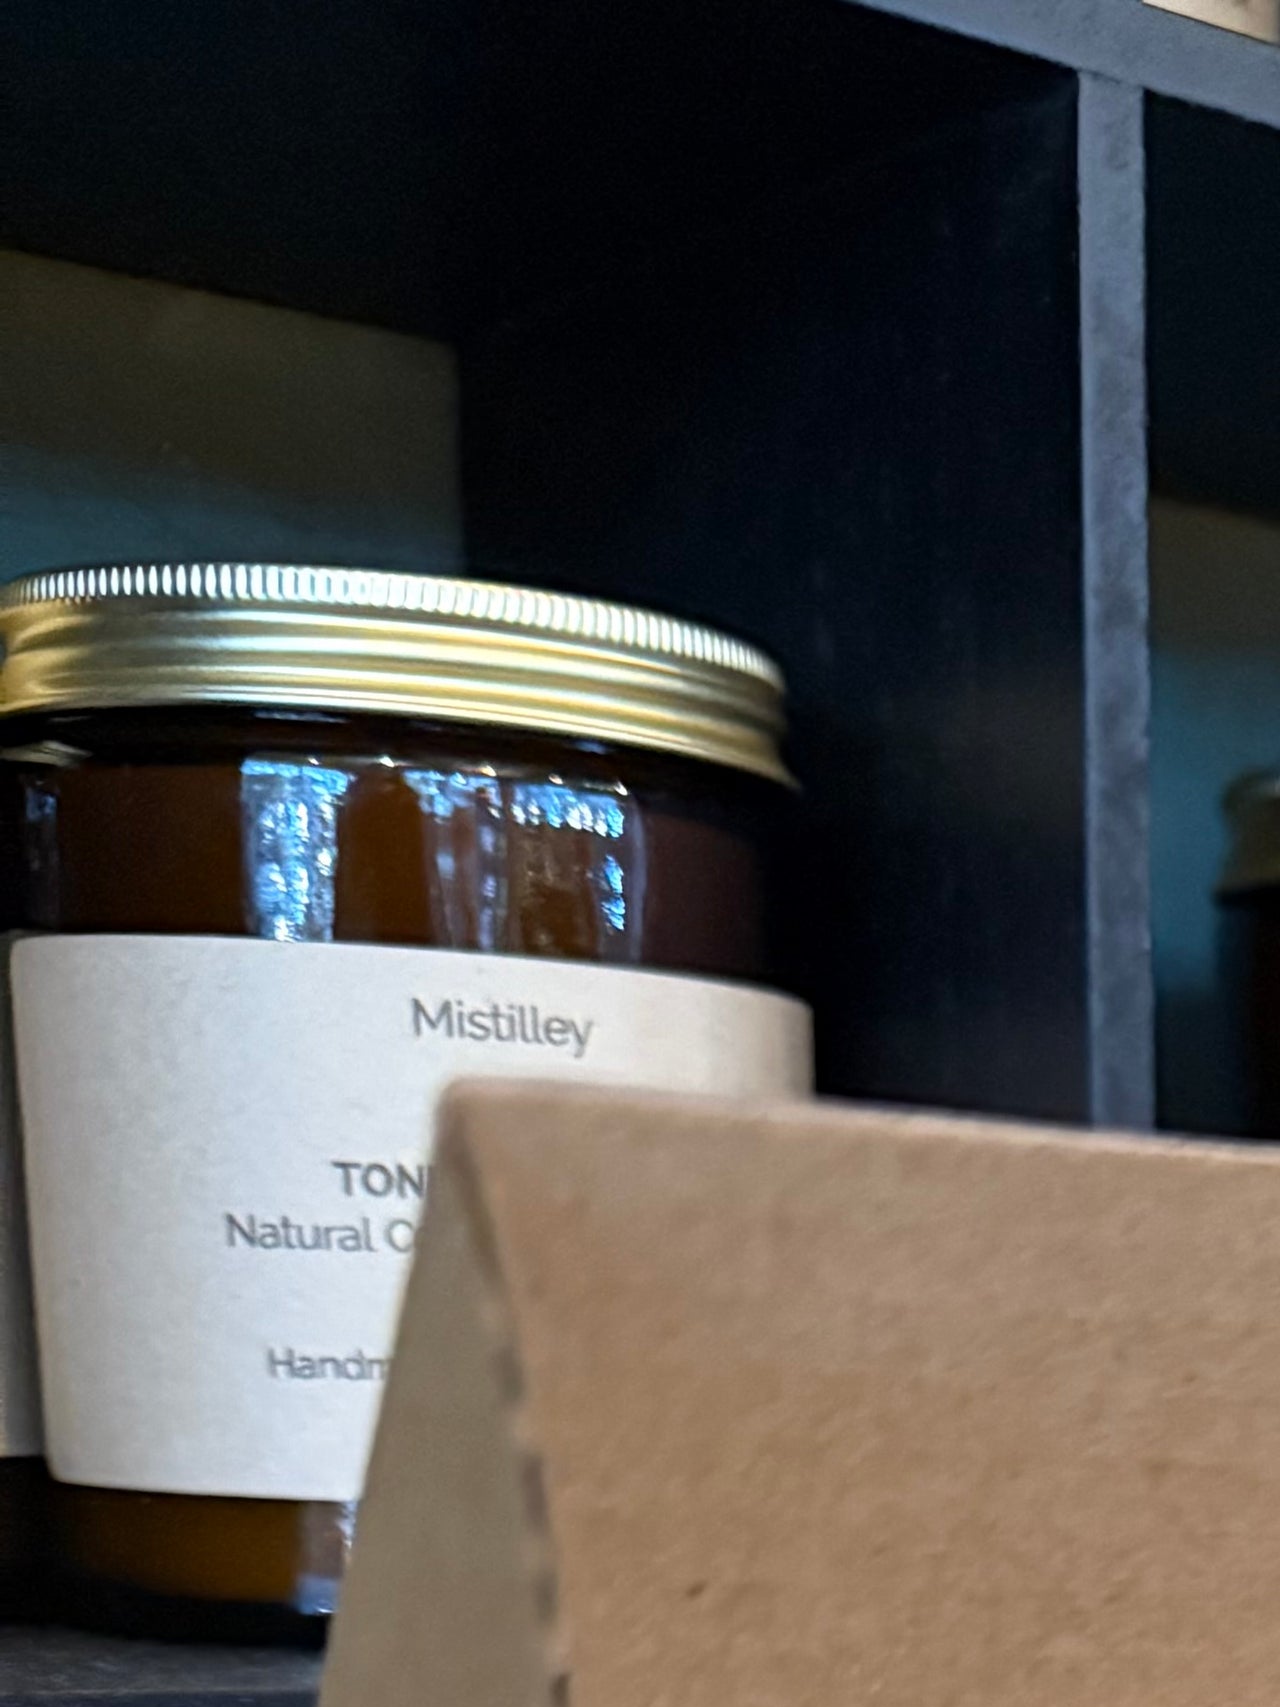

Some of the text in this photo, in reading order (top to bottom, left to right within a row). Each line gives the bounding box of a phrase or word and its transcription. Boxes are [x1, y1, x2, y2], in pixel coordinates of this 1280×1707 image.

[410, 998, 593, 1058] Mistilley
[332, 1161, 432, 1197] TON
[226, 1214, 375, 1253] Natural
